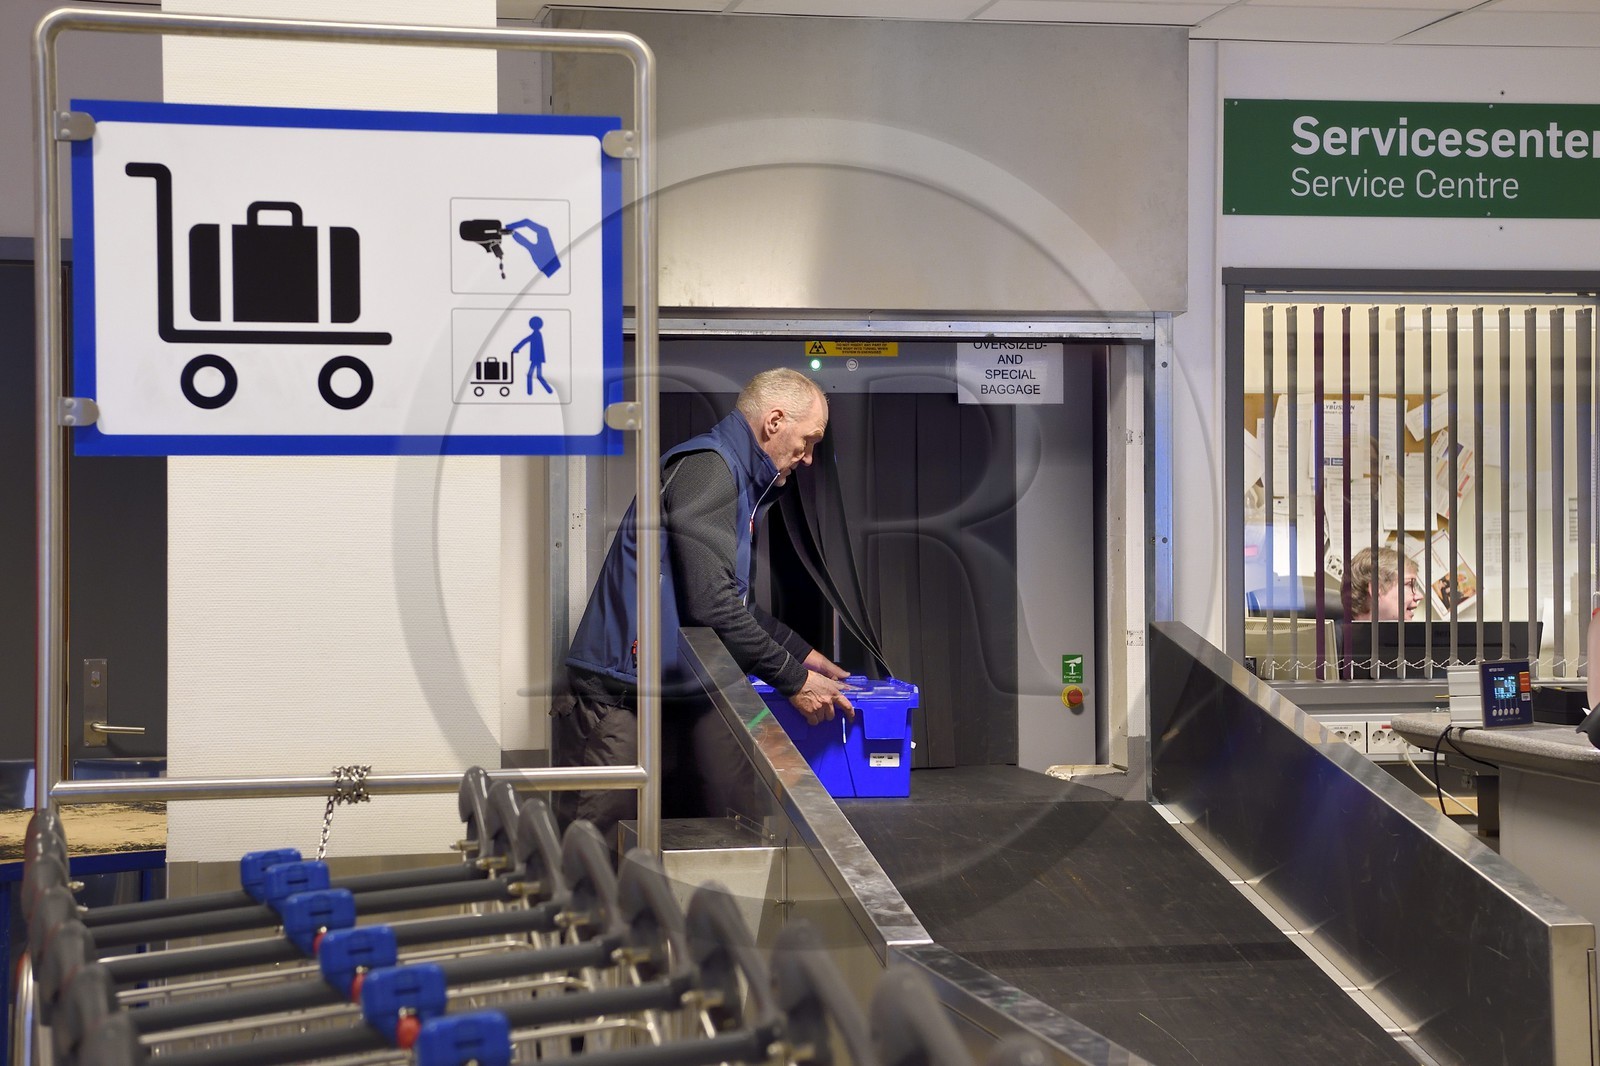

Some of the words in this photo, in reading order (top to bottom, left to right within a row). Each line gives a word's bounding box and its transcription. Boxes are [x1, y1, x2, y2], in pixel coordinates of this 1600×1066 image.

[1291, 167, 1405, 198] Service
[1415, 169, 1520, 199] Centre
[973, 342, 1047, 350] OVERSIZED-
[997, 354, 1024, 365] AND
[985, 369, 1037, 380] SPECIAL
[980, 384, 1041, 395] BAGGAGE
